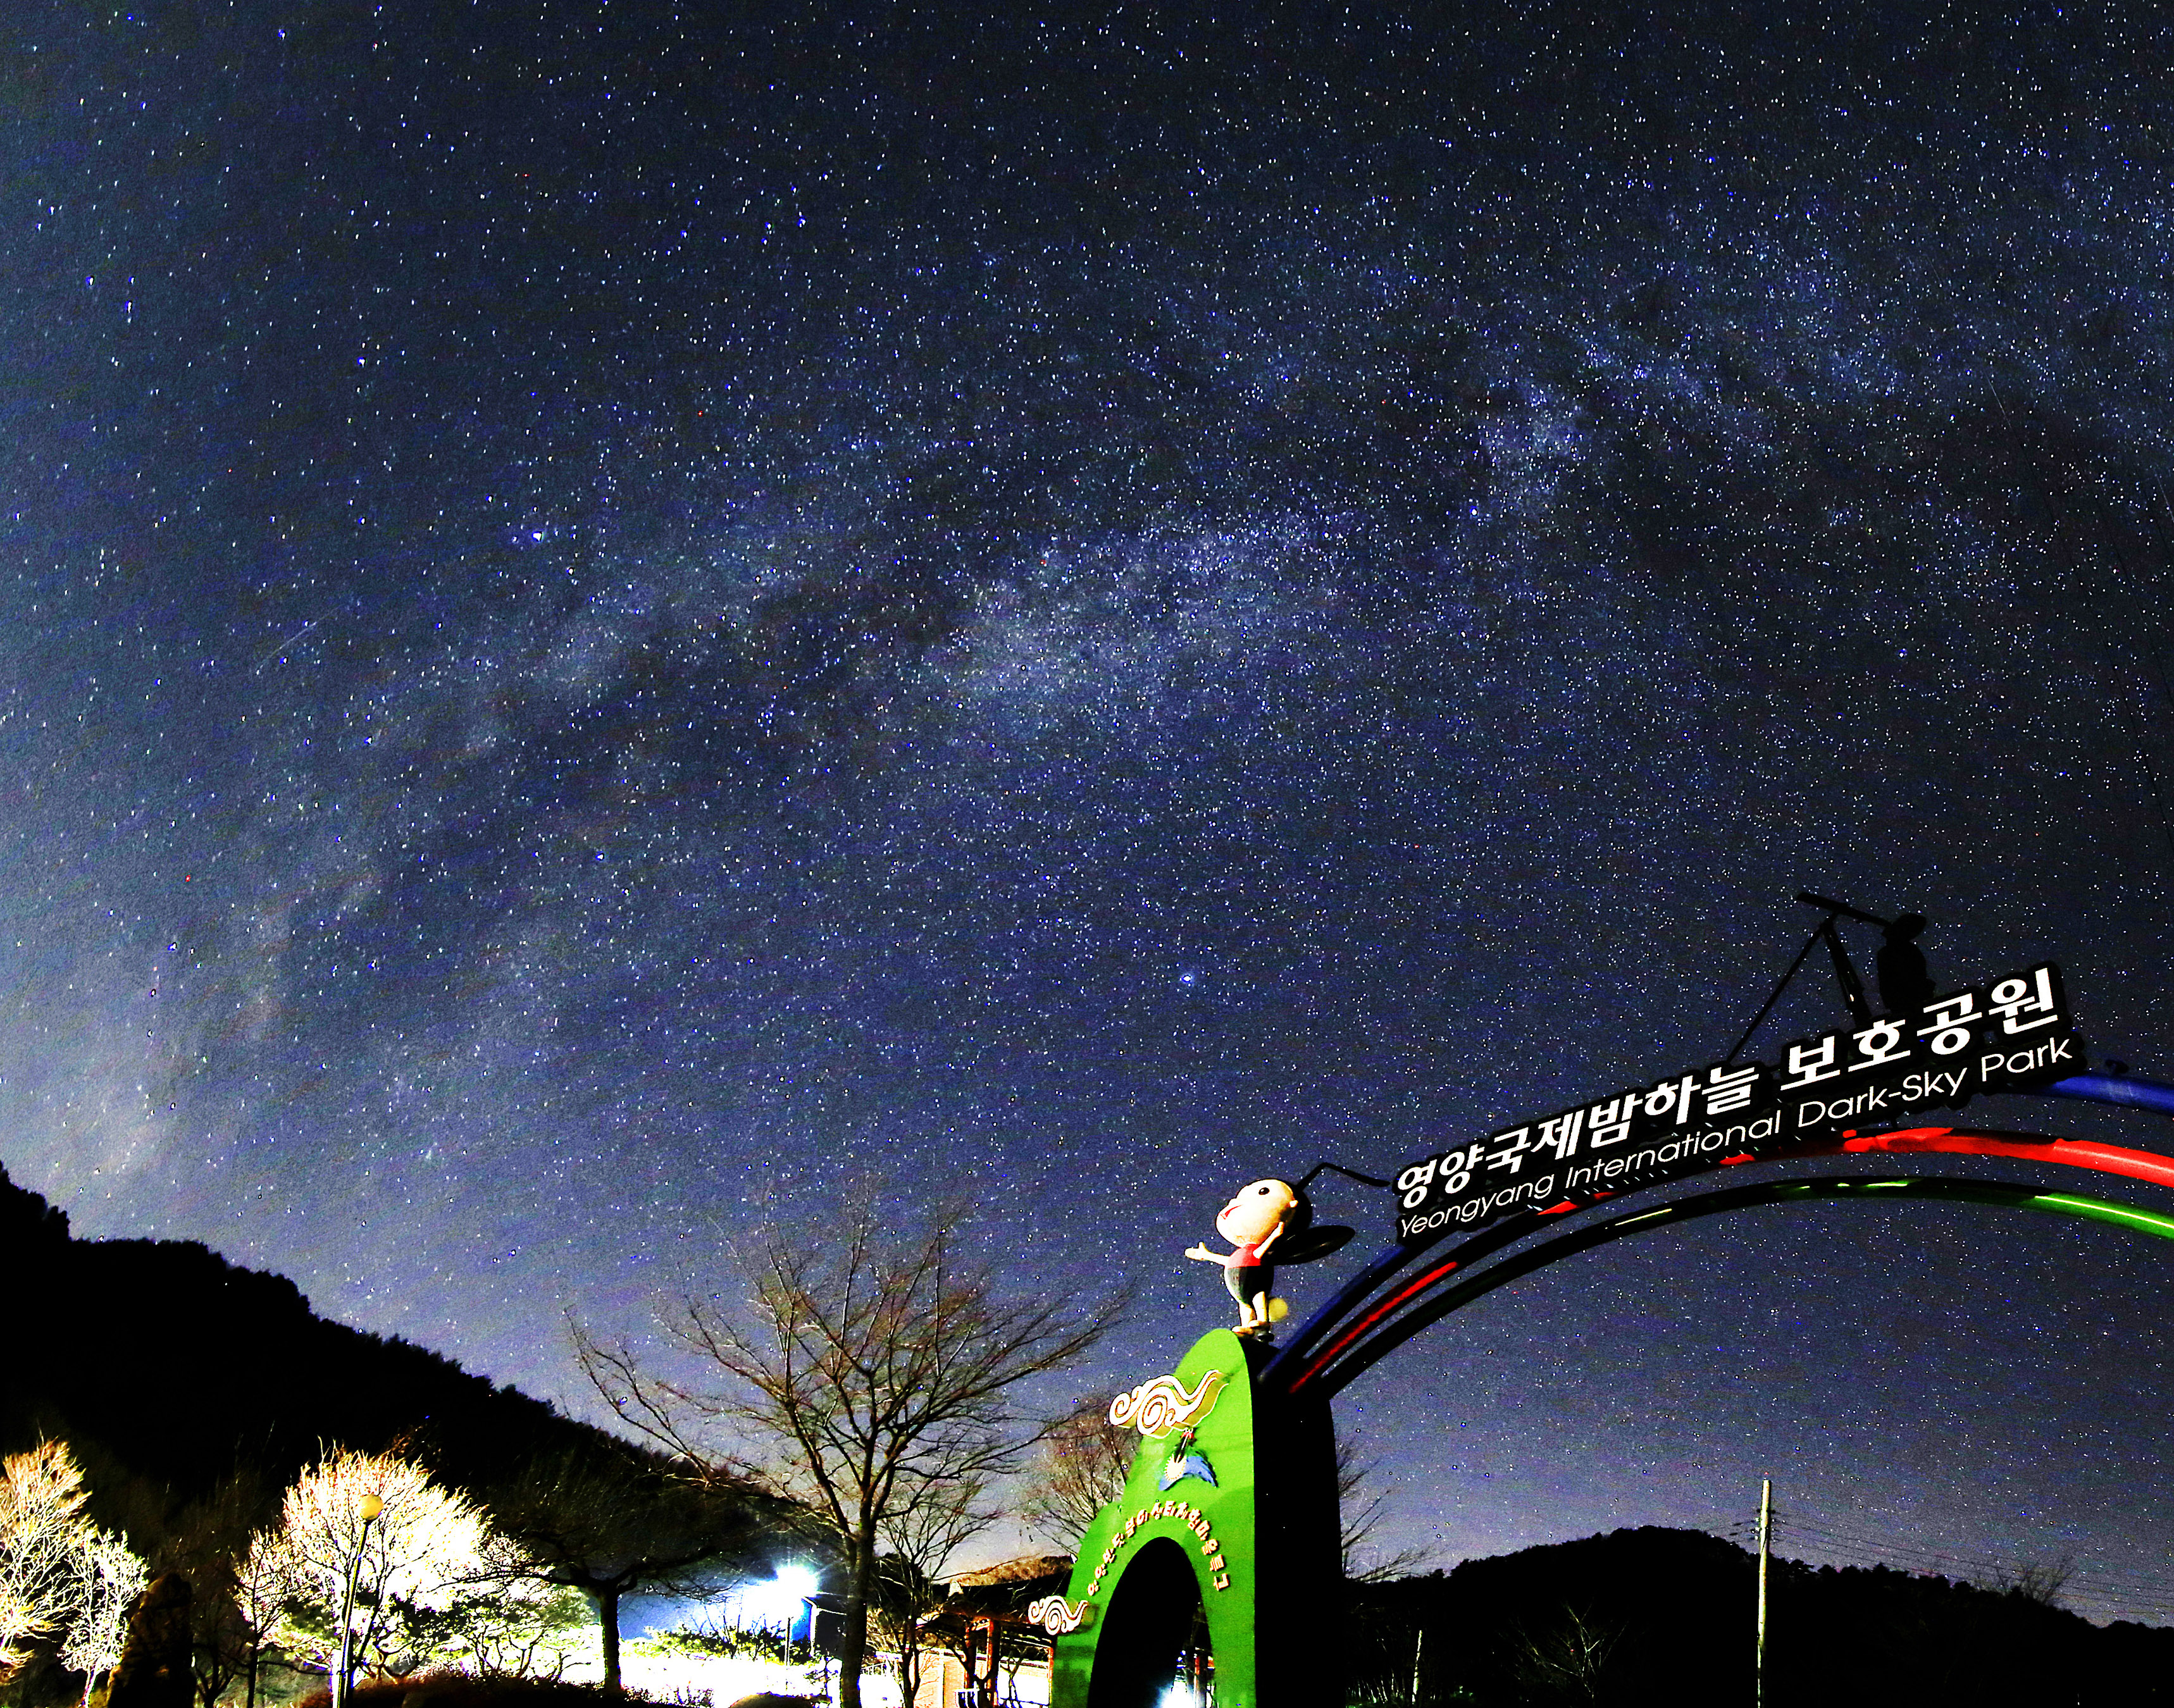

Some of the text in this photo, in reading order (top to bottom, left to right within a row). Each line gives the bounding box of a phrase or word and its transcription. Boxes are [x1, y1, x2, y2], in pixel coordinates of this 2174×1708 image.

[1397, 967, 2059, 1210] 영양국제밤하늘 보호공원
[1400, 1036, 2073, 1238] Yeongyang International Dark-Sky Park
